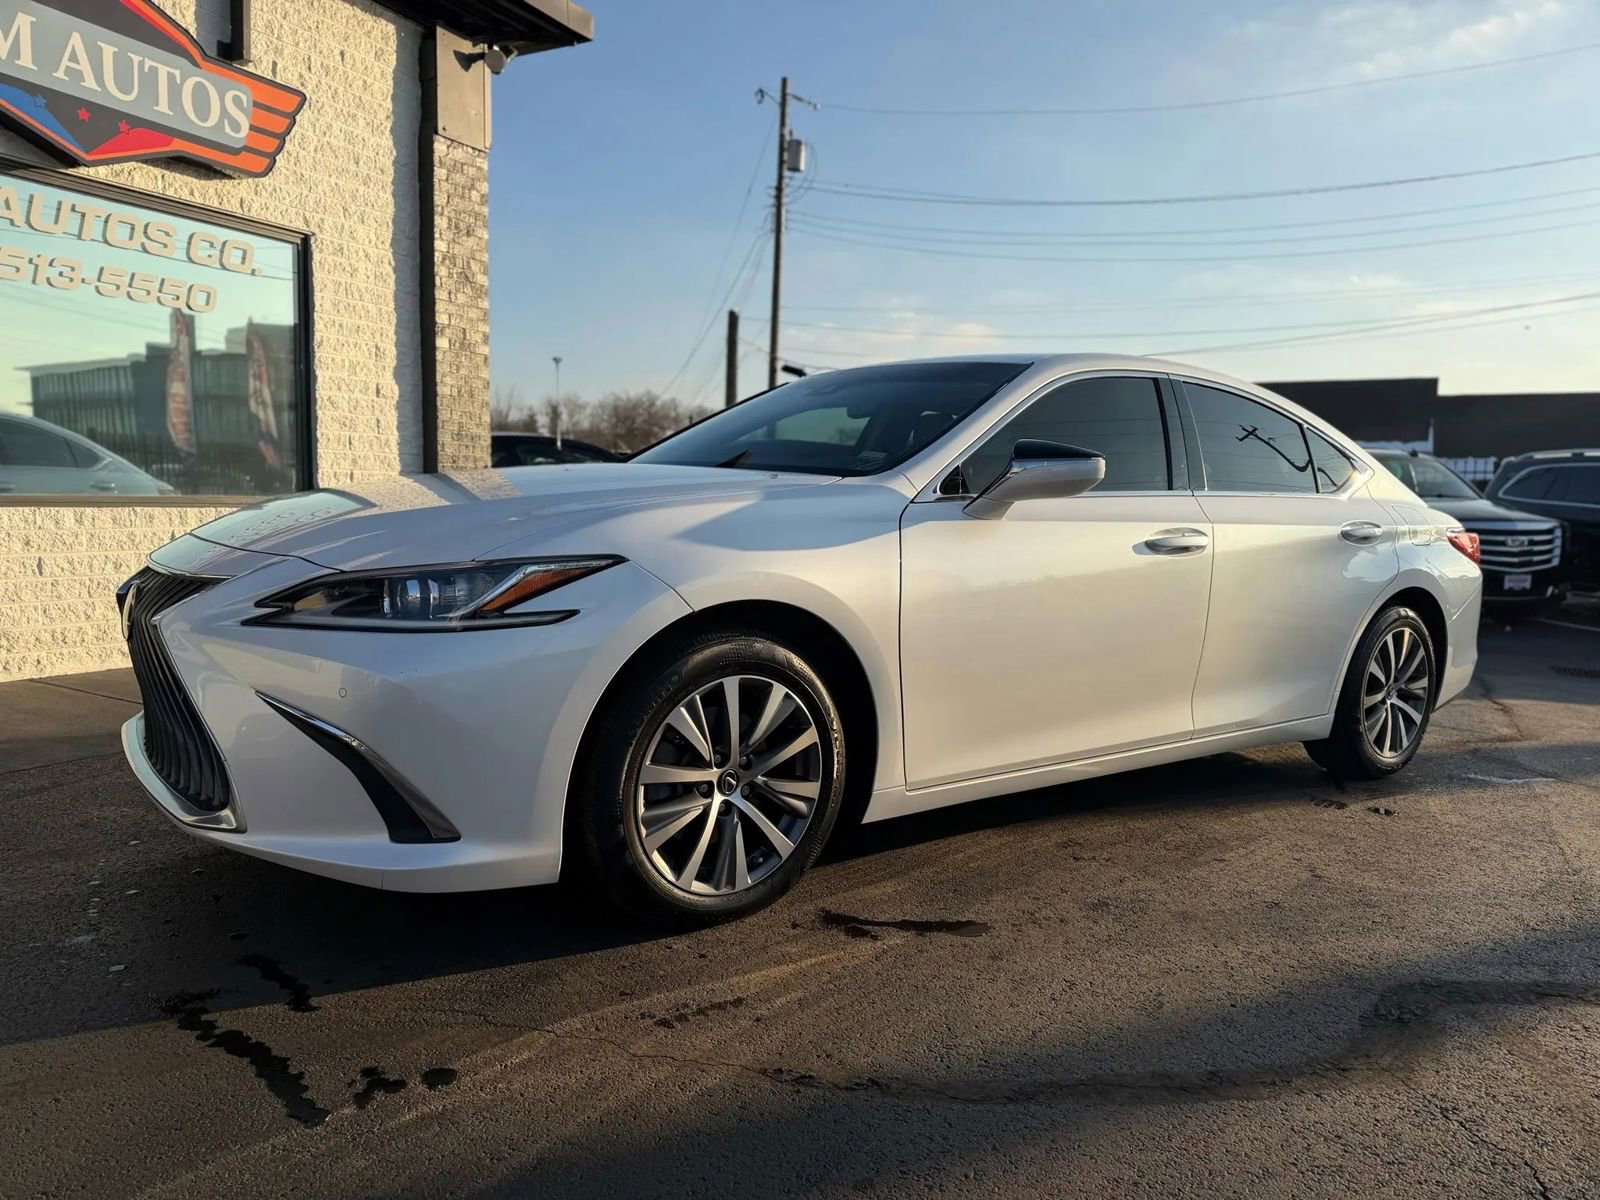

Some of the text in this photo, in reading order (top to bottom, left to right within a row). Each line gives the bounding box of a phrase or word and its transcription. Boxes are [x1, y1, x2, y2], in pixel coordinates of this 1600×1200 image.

[52, 31, 251, 139] AUTOS
[0, 185, 263, 277] AUTOS CO.
[0, 245, 217, 313] 513-5550
